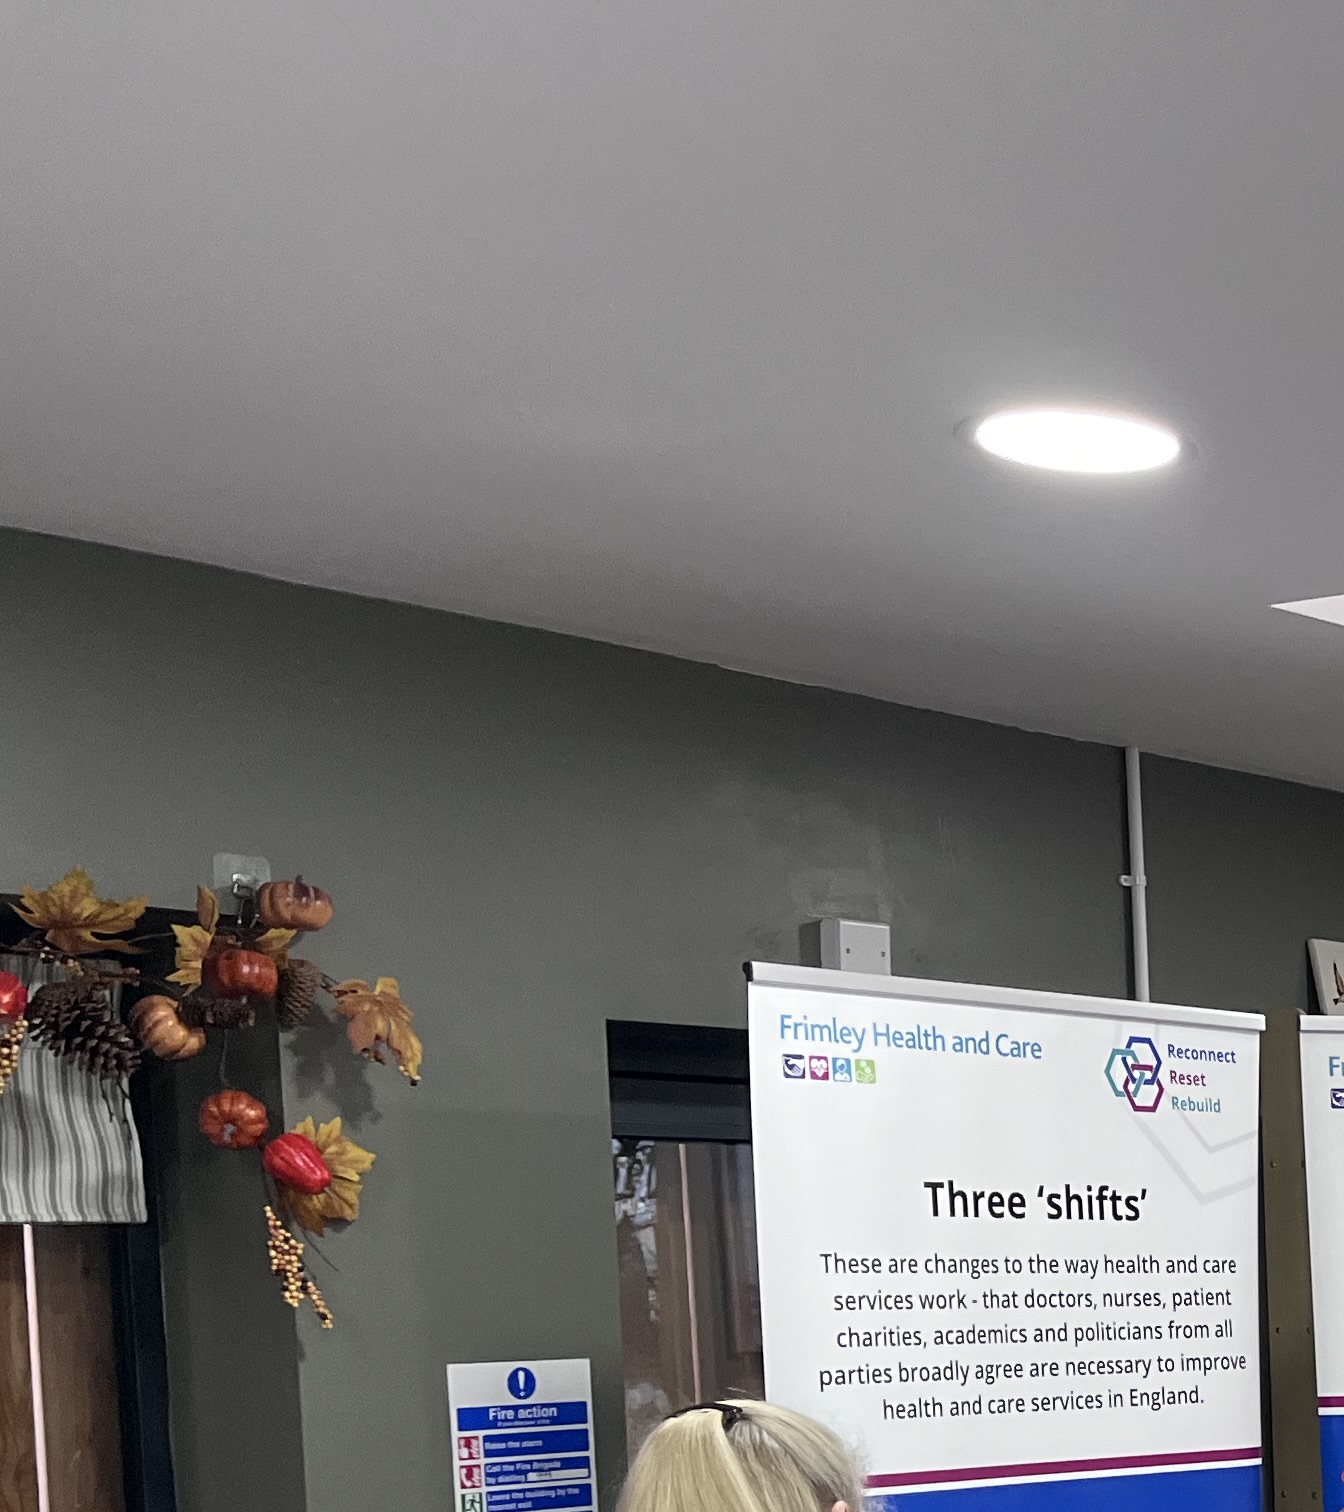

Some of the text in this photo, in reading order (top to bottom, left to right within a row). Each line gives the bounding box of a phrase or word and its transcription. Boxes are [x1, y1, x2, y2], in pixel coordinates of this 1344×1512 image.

[780, 1014, 1043, 1060] Frimley Health and Care
[1167, 1043, 1237, 1064] Reconnect
[1169, 1069, 1207, 1087] Reset
[1171, 1095, 1221, 1114] Rebuild
[923, 1179, 1027, 1220] Three
[819, 1252, 1237, 1280] These are changes to the way health and care
[836, 1318, 1233, 1349] charities, academics and politicians from all
[488, 1404, 558, 1421] Fire action
